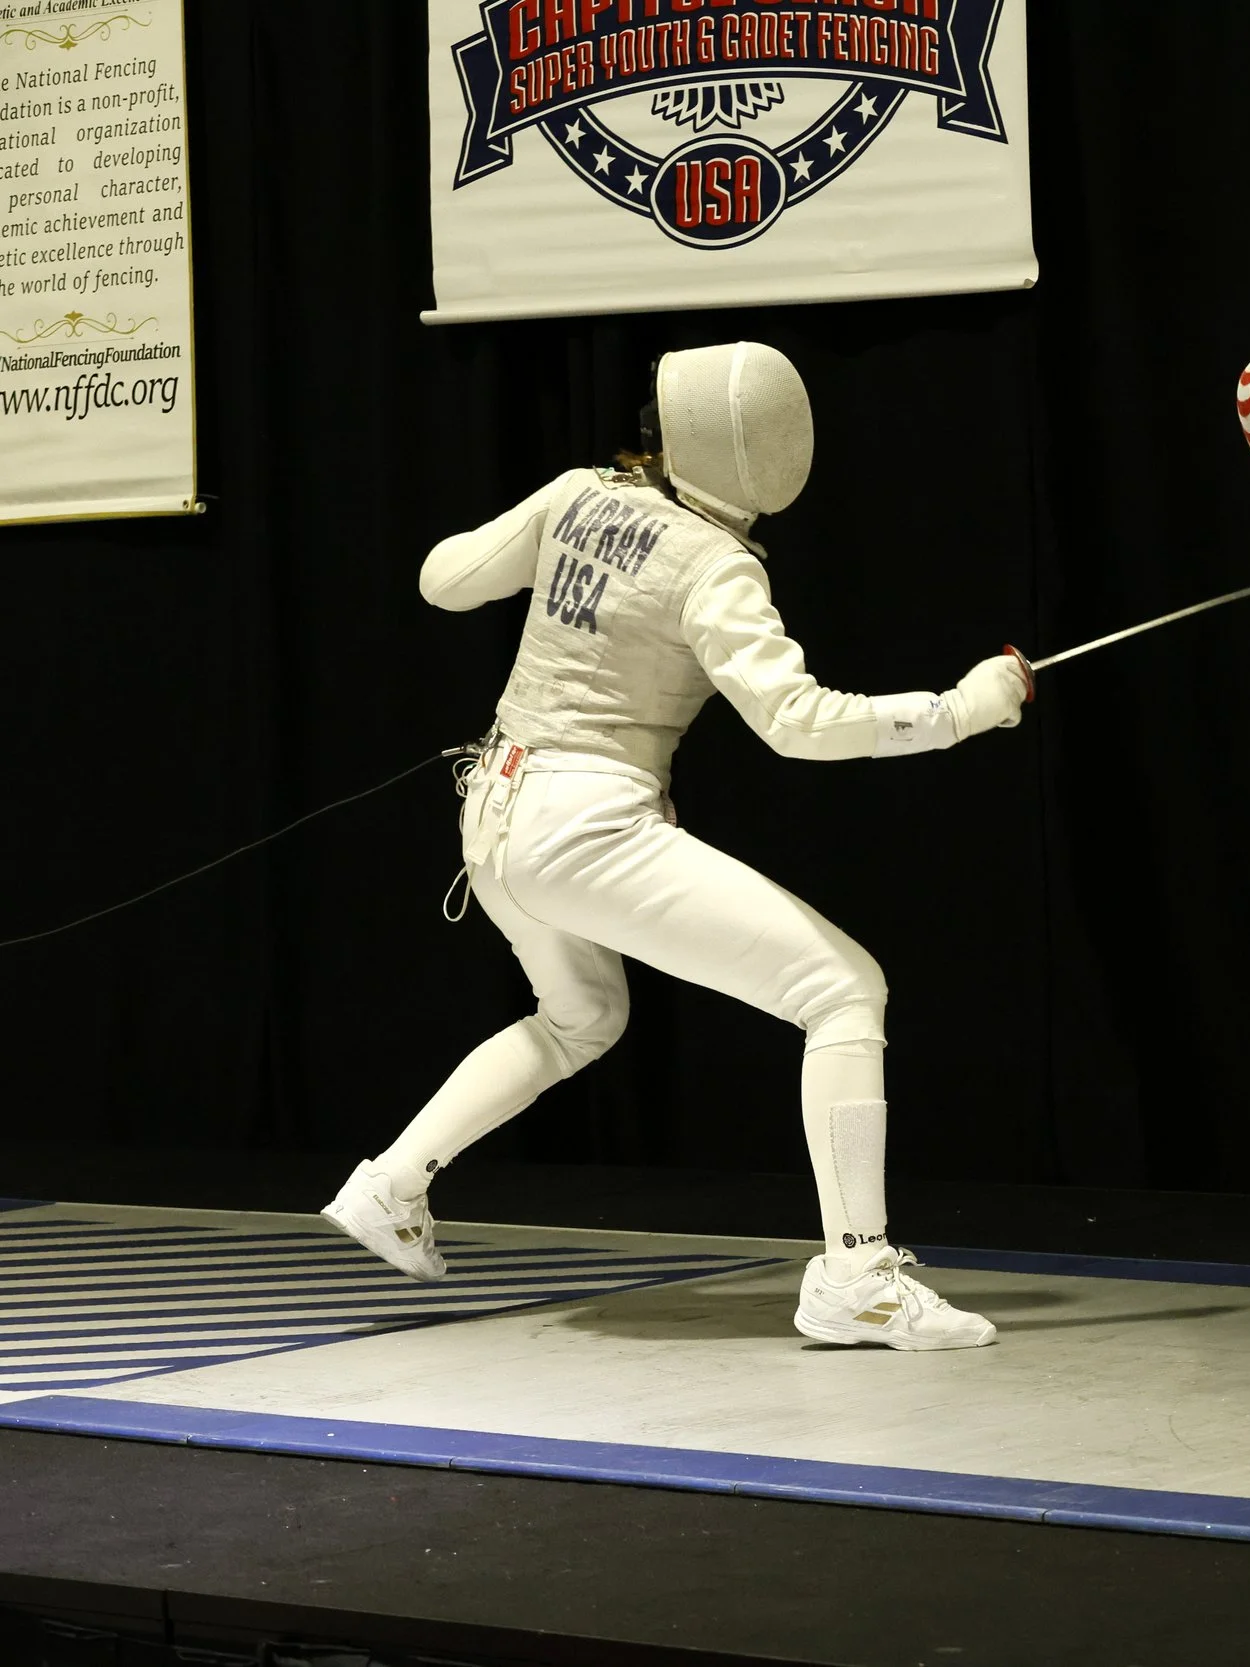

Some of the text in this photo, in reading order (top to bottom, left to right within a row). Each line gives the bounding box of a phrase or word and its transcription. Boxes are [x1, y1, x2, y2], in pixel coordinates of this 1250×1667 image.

[20, 1, 40, 17] and
[16, 64, 88, 90] National
[94, 57, 157, 80] Fencing
[510, 40, 594, 115] SUPER
[600, 18, 691, 80] YOUTH
[722, 12, 811, 61] CADET
[817, 12, 939, 76] FENCING
[0, 83, 179, 121] dation is a non-profit,
[77, 115, 181, 144] organization
[58, 157, 74, 173] to
[93, 144, 181, 169] developing
[8, 175, 182, 213] personal character,
[674, 155, 763, 229] USA
[44, 207, 145, 234] achievement
[152, 201, 184, 222] and
[31, 242, 113, 265] excellence
[119, 232, 184, 256] through
[21, 273, 66, 293] world
[73, 270, 91, 294] of
[93, 268, 158, 293] fencing.
[546, 552, 609, 635] USA
